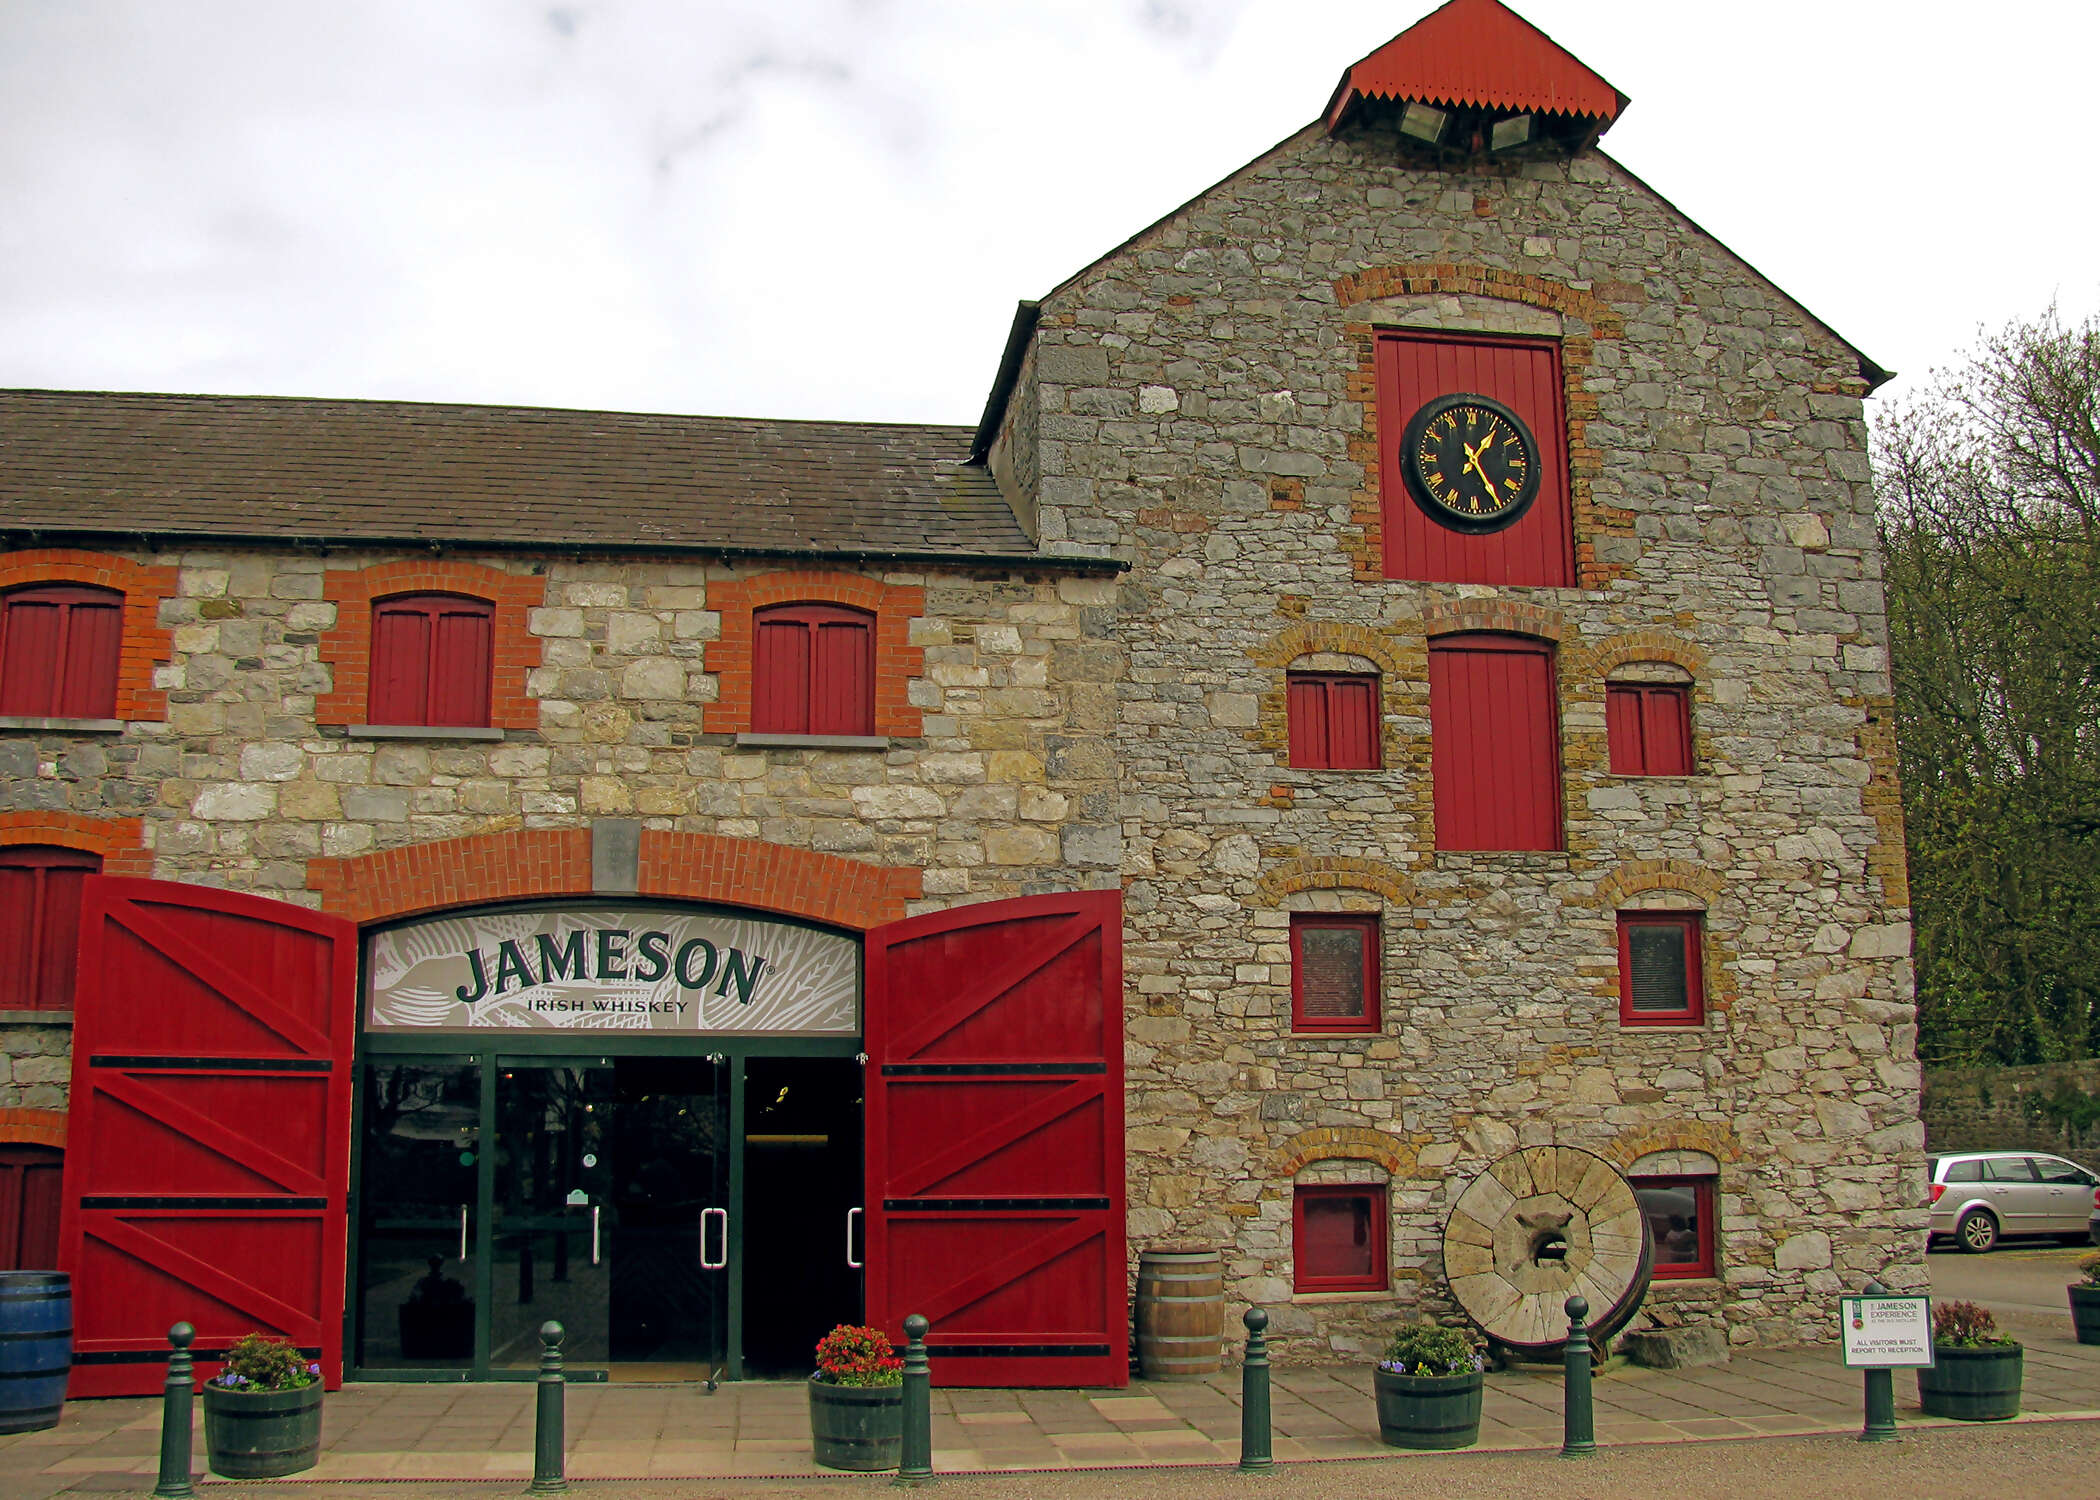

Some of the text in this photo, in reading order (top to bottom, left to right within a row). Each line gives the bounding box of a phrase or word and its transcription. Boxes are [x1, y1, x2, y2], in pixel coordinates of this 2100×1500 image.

[456, 929, 768, 1006] JAMESON
[527, 1000, 688, 1013] IRISH WHISKEY
[1877, 1302, 1917, 1310] JAMESON
[1871, 1310, 1918, 1318] EXPERIENCE
